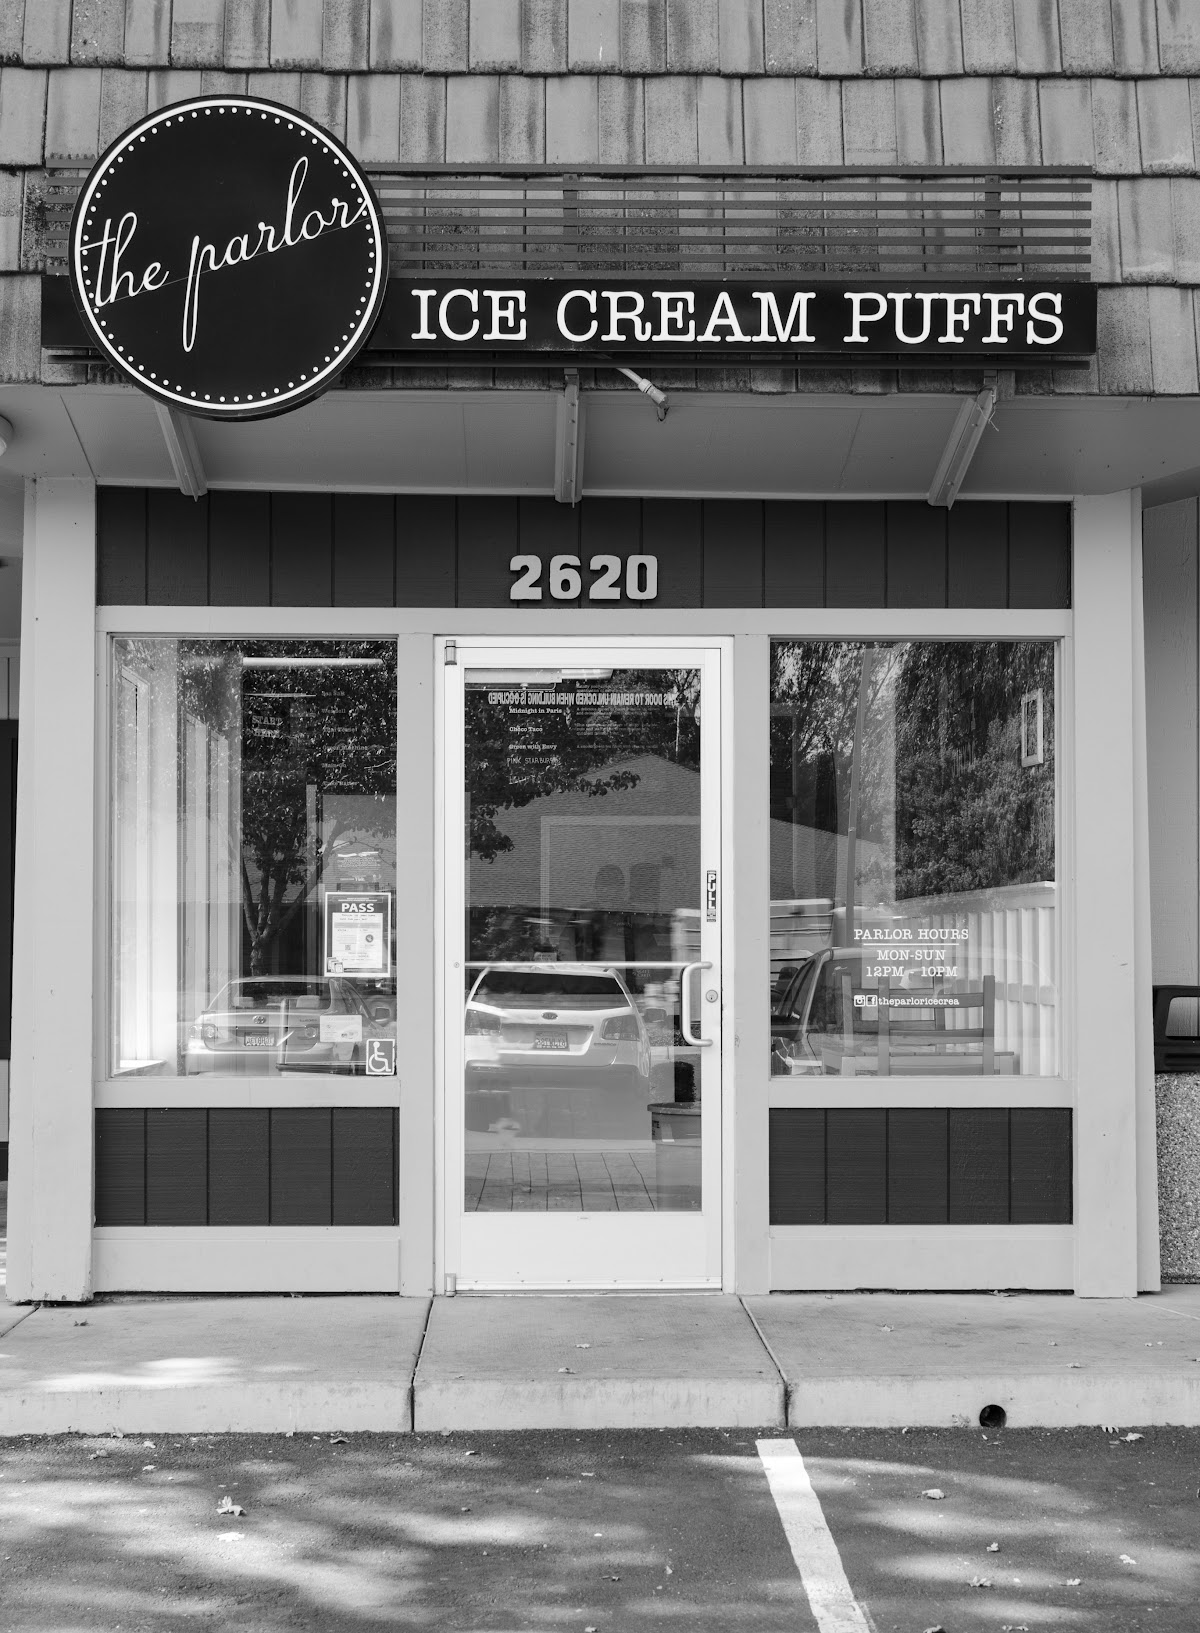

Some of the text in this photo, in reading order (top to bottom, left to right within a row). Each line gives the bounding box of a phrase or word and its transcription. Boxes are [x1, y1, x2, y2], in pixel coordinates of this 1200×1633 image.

[79, 156, 368, 352] the parlor
[411, 288, 1064, 345] ICE CREAM PUFFS
[510, 554, 658, 600] 2620
[509, 707, 538, 715] Midnight
[707, 873, 716, 909] PULL
[341, 902, 375, 913] PASS
[853, 928, 969, 940] PARLOR HOURS
[876, 949, 947, 961] MON-SUN
[866, 966, 905, 977] 12PM
[921, 966, 958, 977] 10PM
[878, 997, 960, 1006] theparloricecrea
